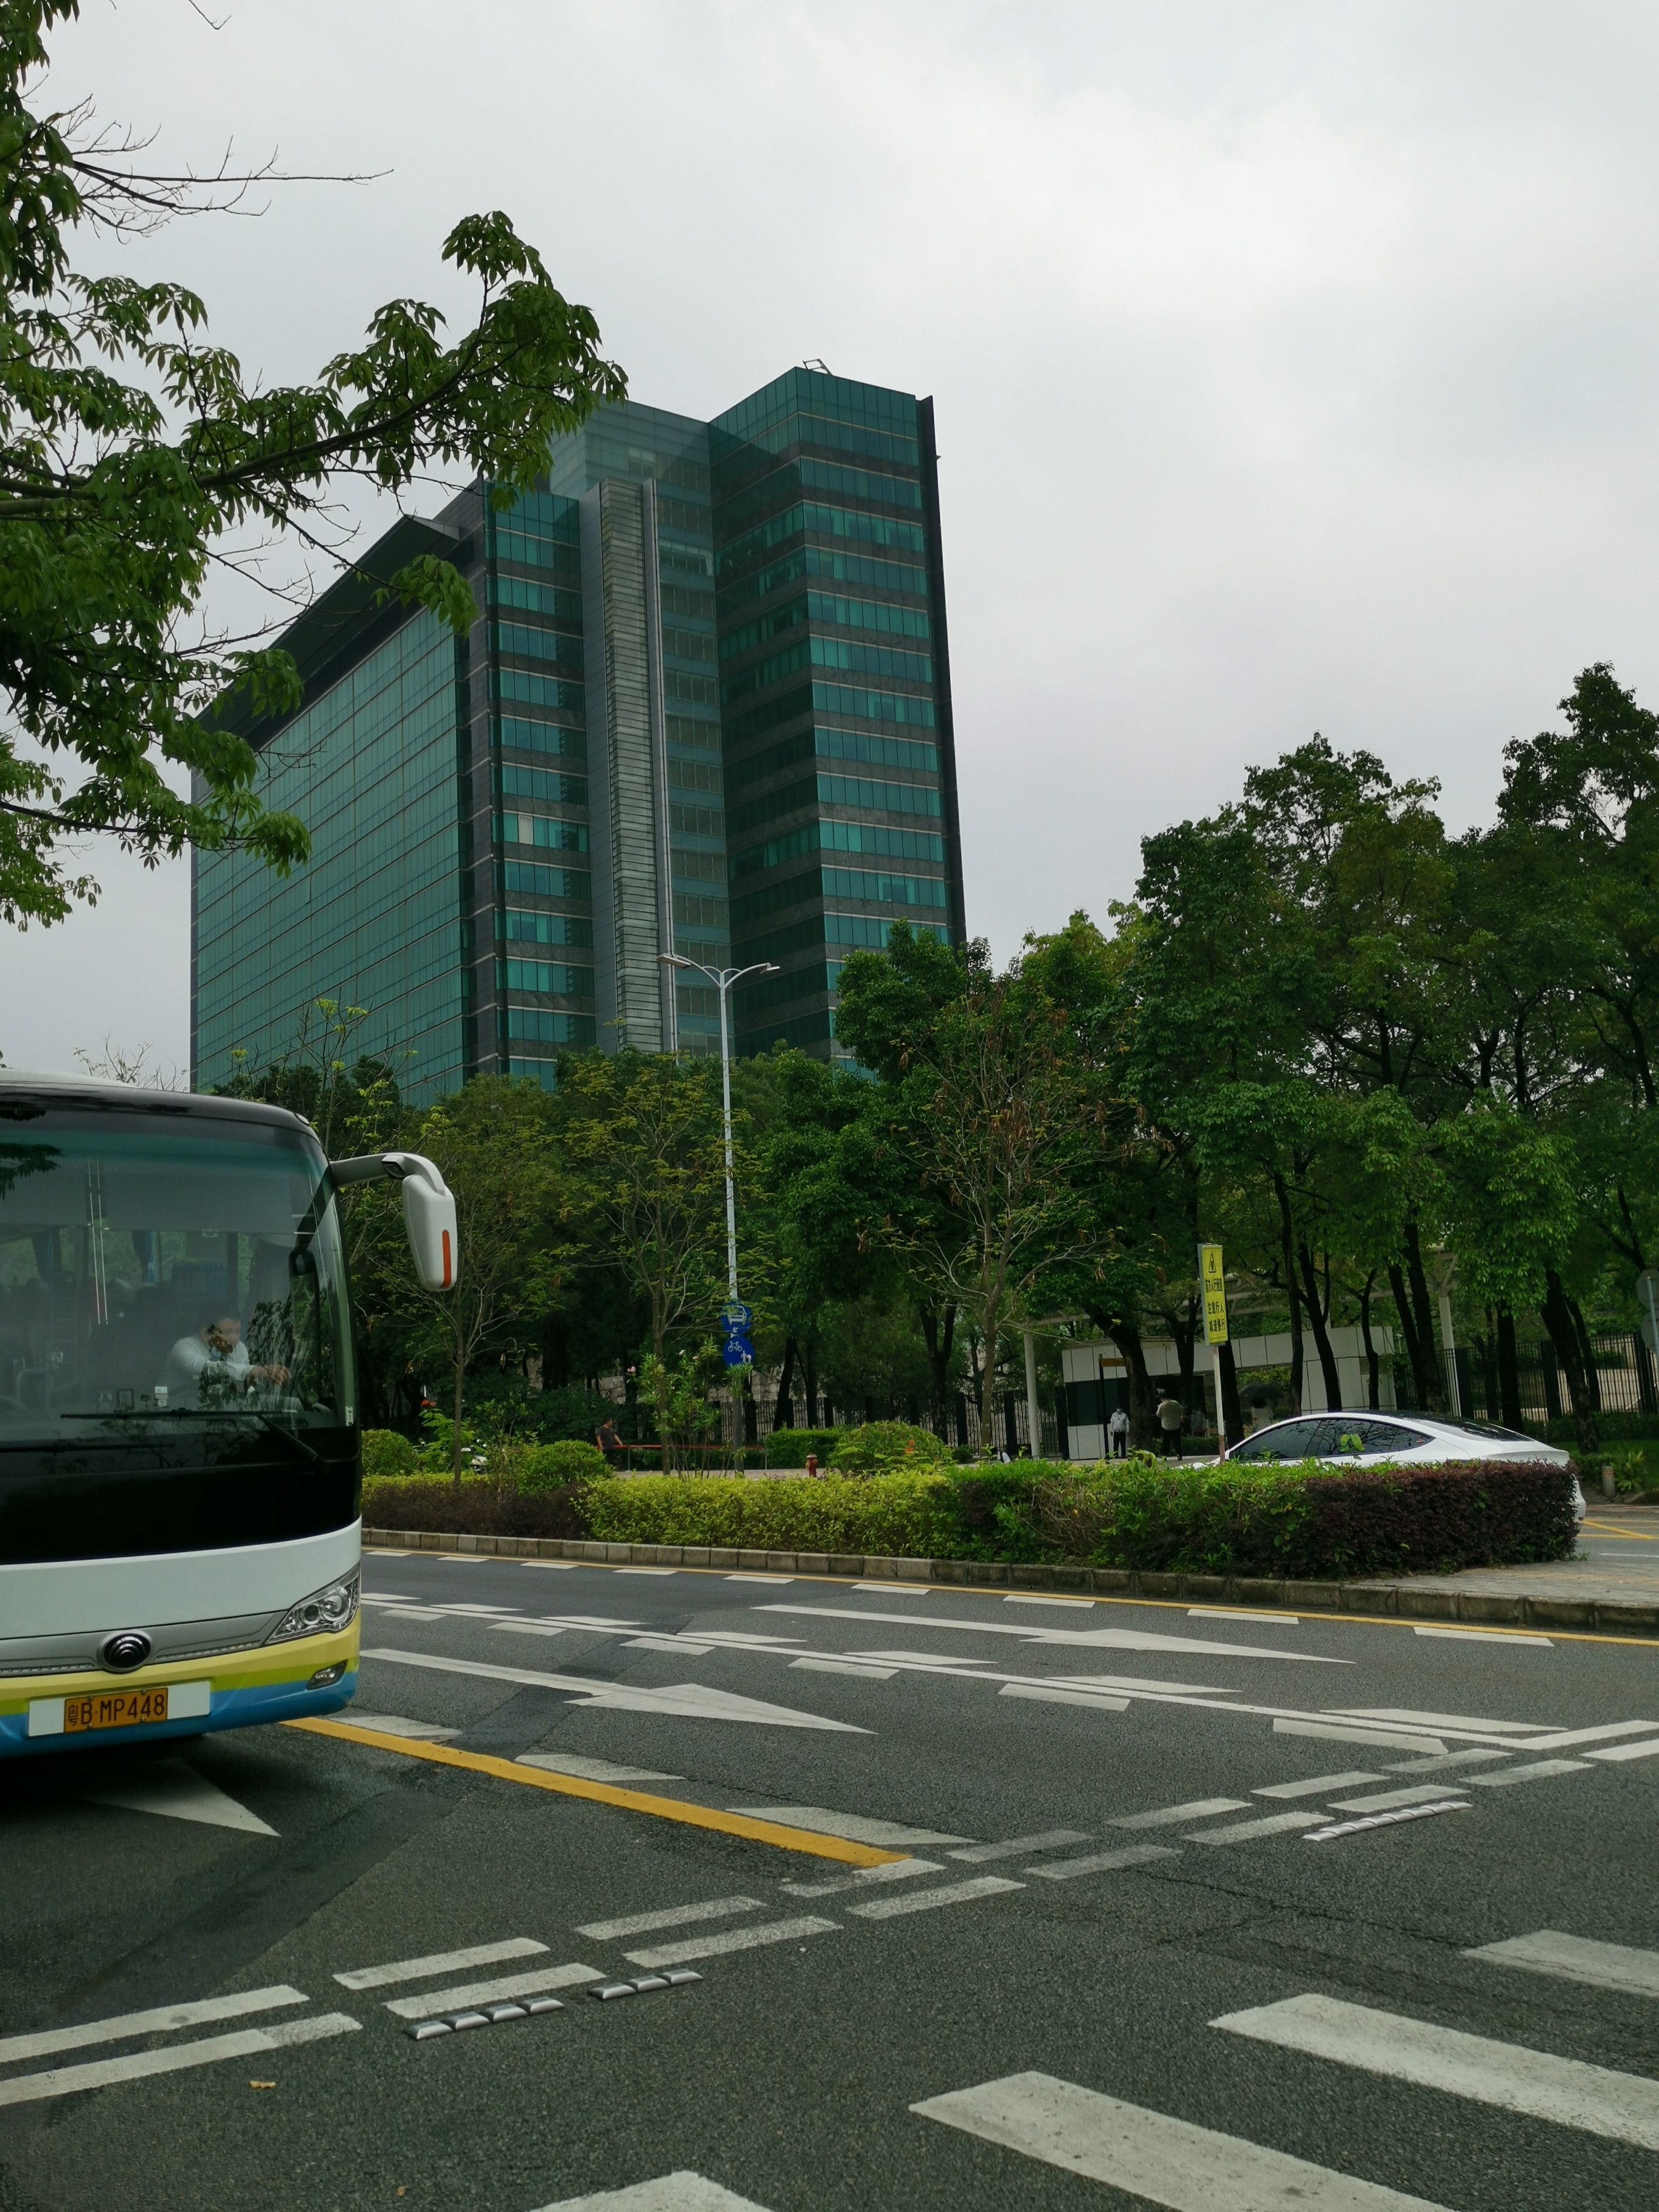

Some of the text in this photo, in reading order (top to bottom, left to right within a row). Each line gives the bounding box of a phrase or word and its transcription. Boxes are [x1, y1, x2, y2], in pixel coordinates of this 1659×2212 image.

[1207, 1301, 1224, 1315] 注意行人
[1208, 1318, 1225, 1332] 减速慢行
